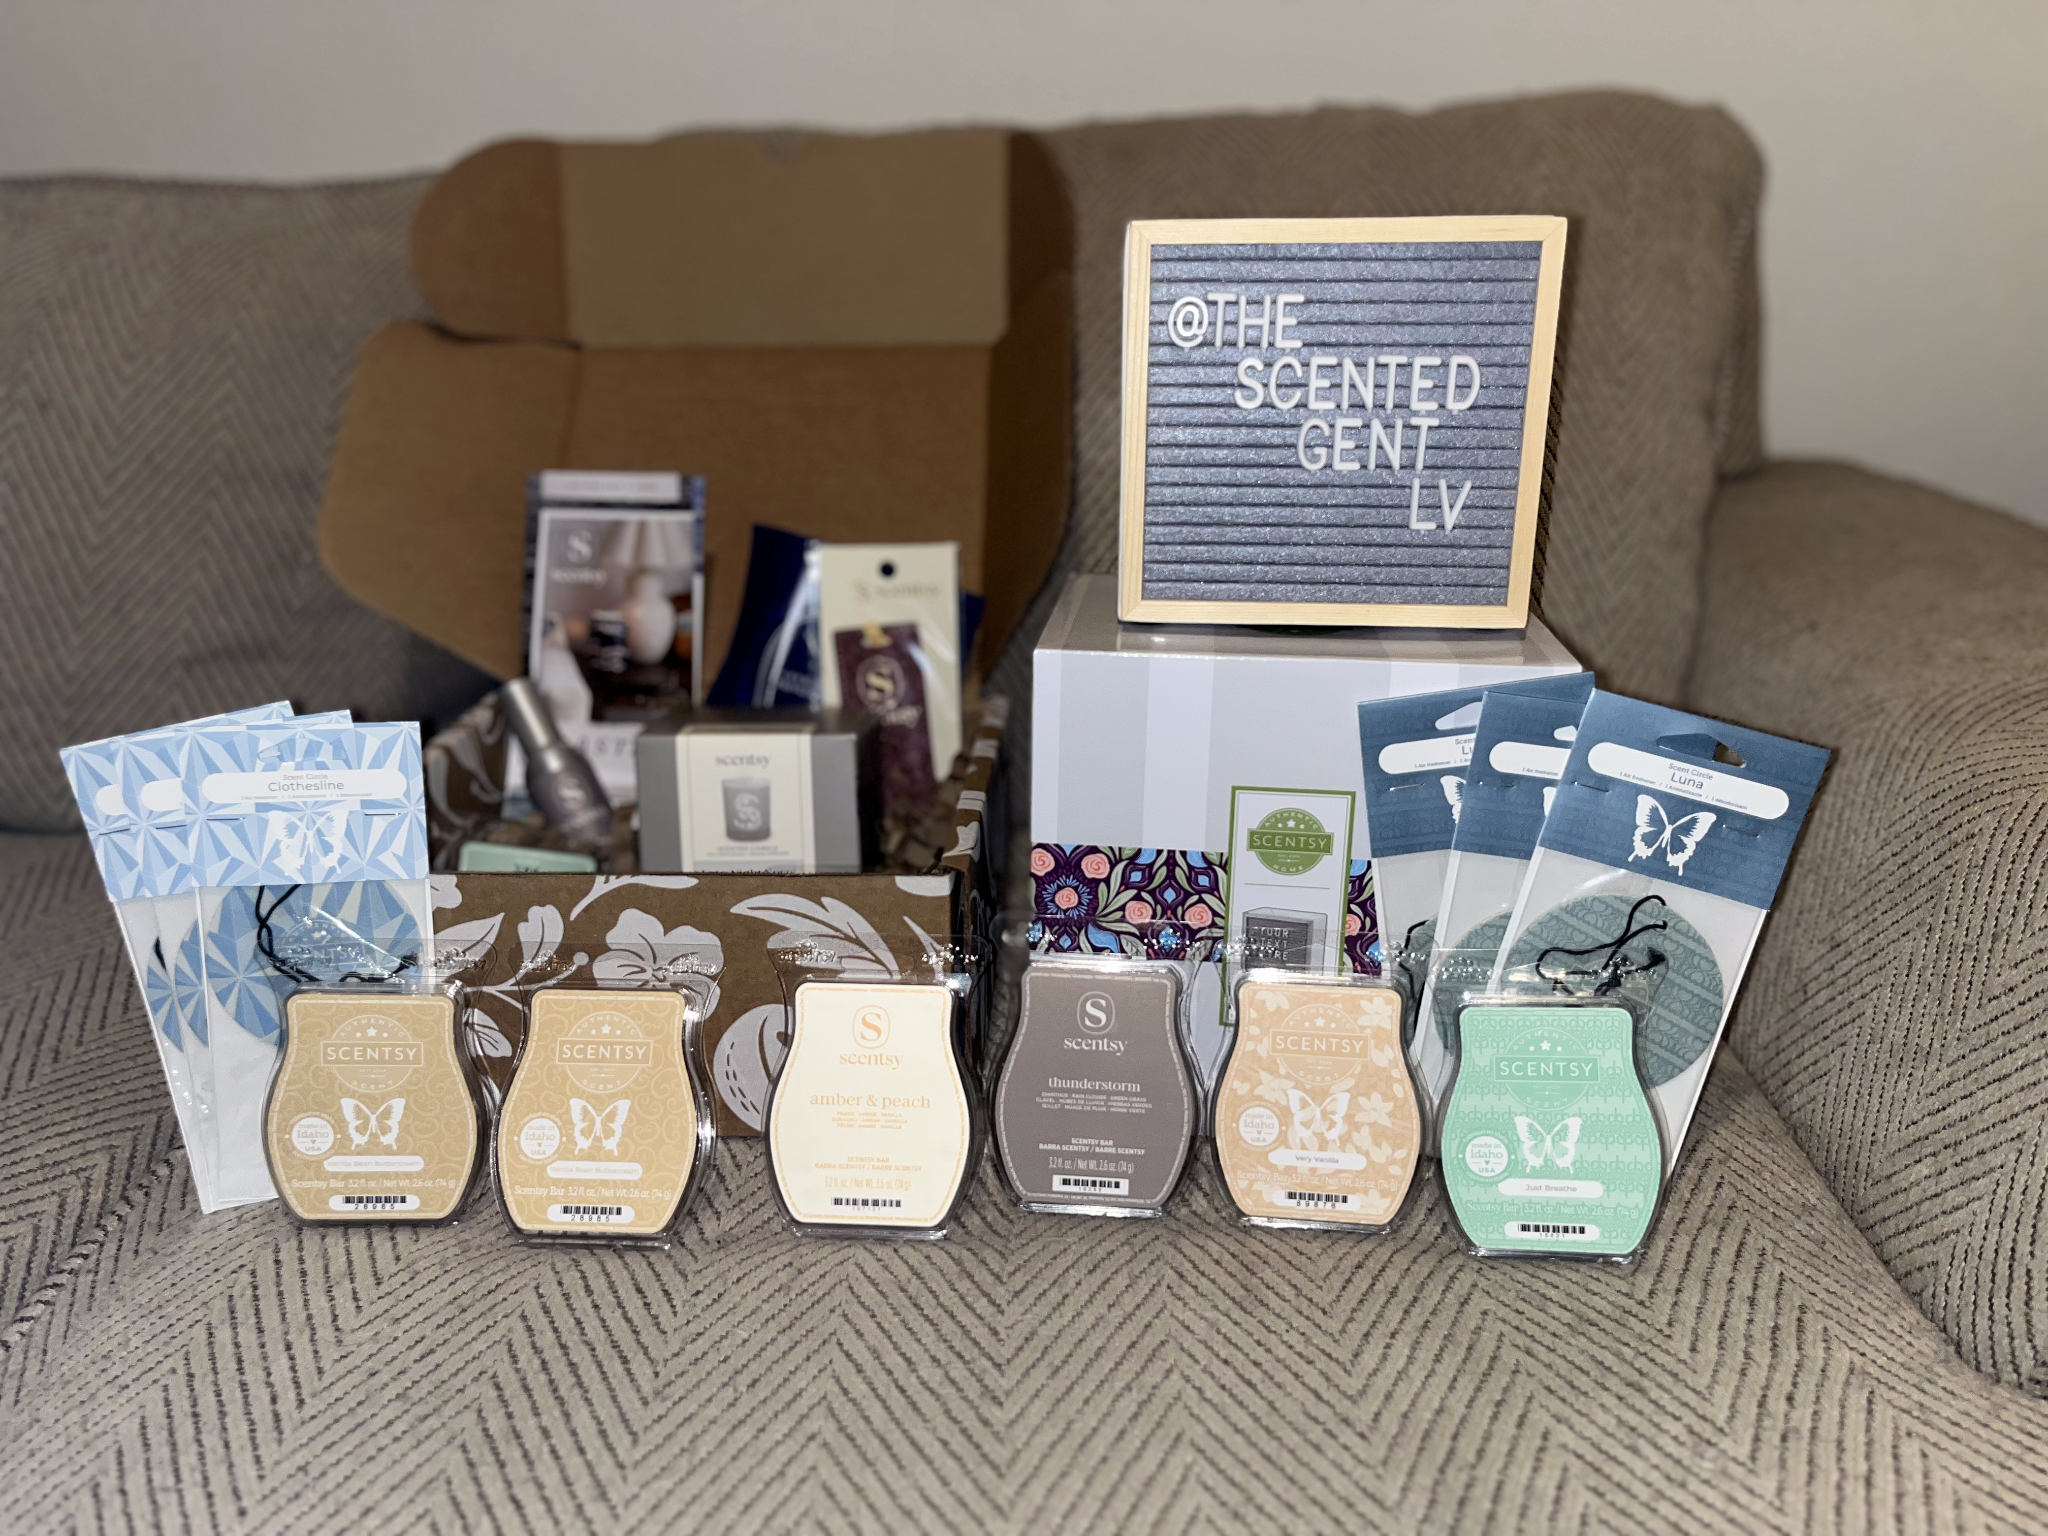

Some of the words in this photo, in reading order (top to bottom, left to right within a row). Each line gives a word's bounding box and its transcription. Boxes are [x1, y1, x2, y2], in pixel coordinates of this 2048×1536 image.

[1168, 293, 1304, 350] @THE
[1234, 355, 1480, 412] SCENTED
[1298, 417, 1439, 472] GENT
[1409, 478, 1472, 532] LV
[715, 754, 770, 769] scentsy
[1668, 763, 1690, 775] Scent
[1691, 769, 1714, 781] Circle
[268, 780, 345, 792] Clothesline
[1670, 772, 1704, 789] Luna
[1264, 811, 1318, 830] AUTHENTIC
[1252, 834, 1327, 849] SCENTSY
[1261, 937, 1288, 949] TEXT
[1084, 998, 1107, 1028] S
[1289, 1007, 1352, 1029] AUTHENTIC
[340, 1017, 405, 1037] AUTHENTIC
[576, 1015, 636, 1035] AUTHENTIC
[860, 1012, 882, 1041] S
[1063, 1037, 1126, 1056] scentsy
[1275, 1035, 1364, 1054] SCENTSY
[1512, 1030, 1580, 1052] AUTHENTIC
[327, 1046, 417, 1061] SCENTSY
[562, 1044, 648, 1060] SCENTSY
[839, 1052, 904, 1070] scentsy
[1499, 1061, 1593, 1077] SCENTSY
[1048, 1076, 1141, 1093] thunderstorm
[810, 1092, 863, 1106] amber
[865, 1093, 878, 1107] &
[881, 1095, 931, 1110] peach
[1243, 1118, 1275, 1129] Idaho
[297, 1129, 329, 1139] Idaho
[525, 1131, 556, 1141] Idaho
[1071, 1137, 1099, 1145] SCENTSY
[1099, 1138, 1114, 1146] BAR
[1062, 1144, 1089, 1152] SCENTSY
[1094, 1146, 1116, 1154] BARRE
[1117, 1147, 1145, 1155] SCENTSY
[1470, 1149, 1503, 1159] Idaho
[1295, 1155, 1312, 1163] Very
[1314, 1156, 1339, 1164] Vanilla
[291, 1178, 328, 1189] Scentsy
[329, 1178, 345, 1187] Bar
[1237, 1169, 1271, 1182] Scentsy
[1273, 1172, 1288, 1182] Bar
[514, 1185, 549, 1197] Scentsy
[549, 1186, 565, 1196] Bar
[1545, 1184, 1578, 1193] Breathe
[1296, 1200, 1336, 1209] 89876
[1466, 1200, 1501, 1213] Scentsy
[1502, 1202, 1517, 1213] Bar
[570, 1214, 611, 1222] 28985
